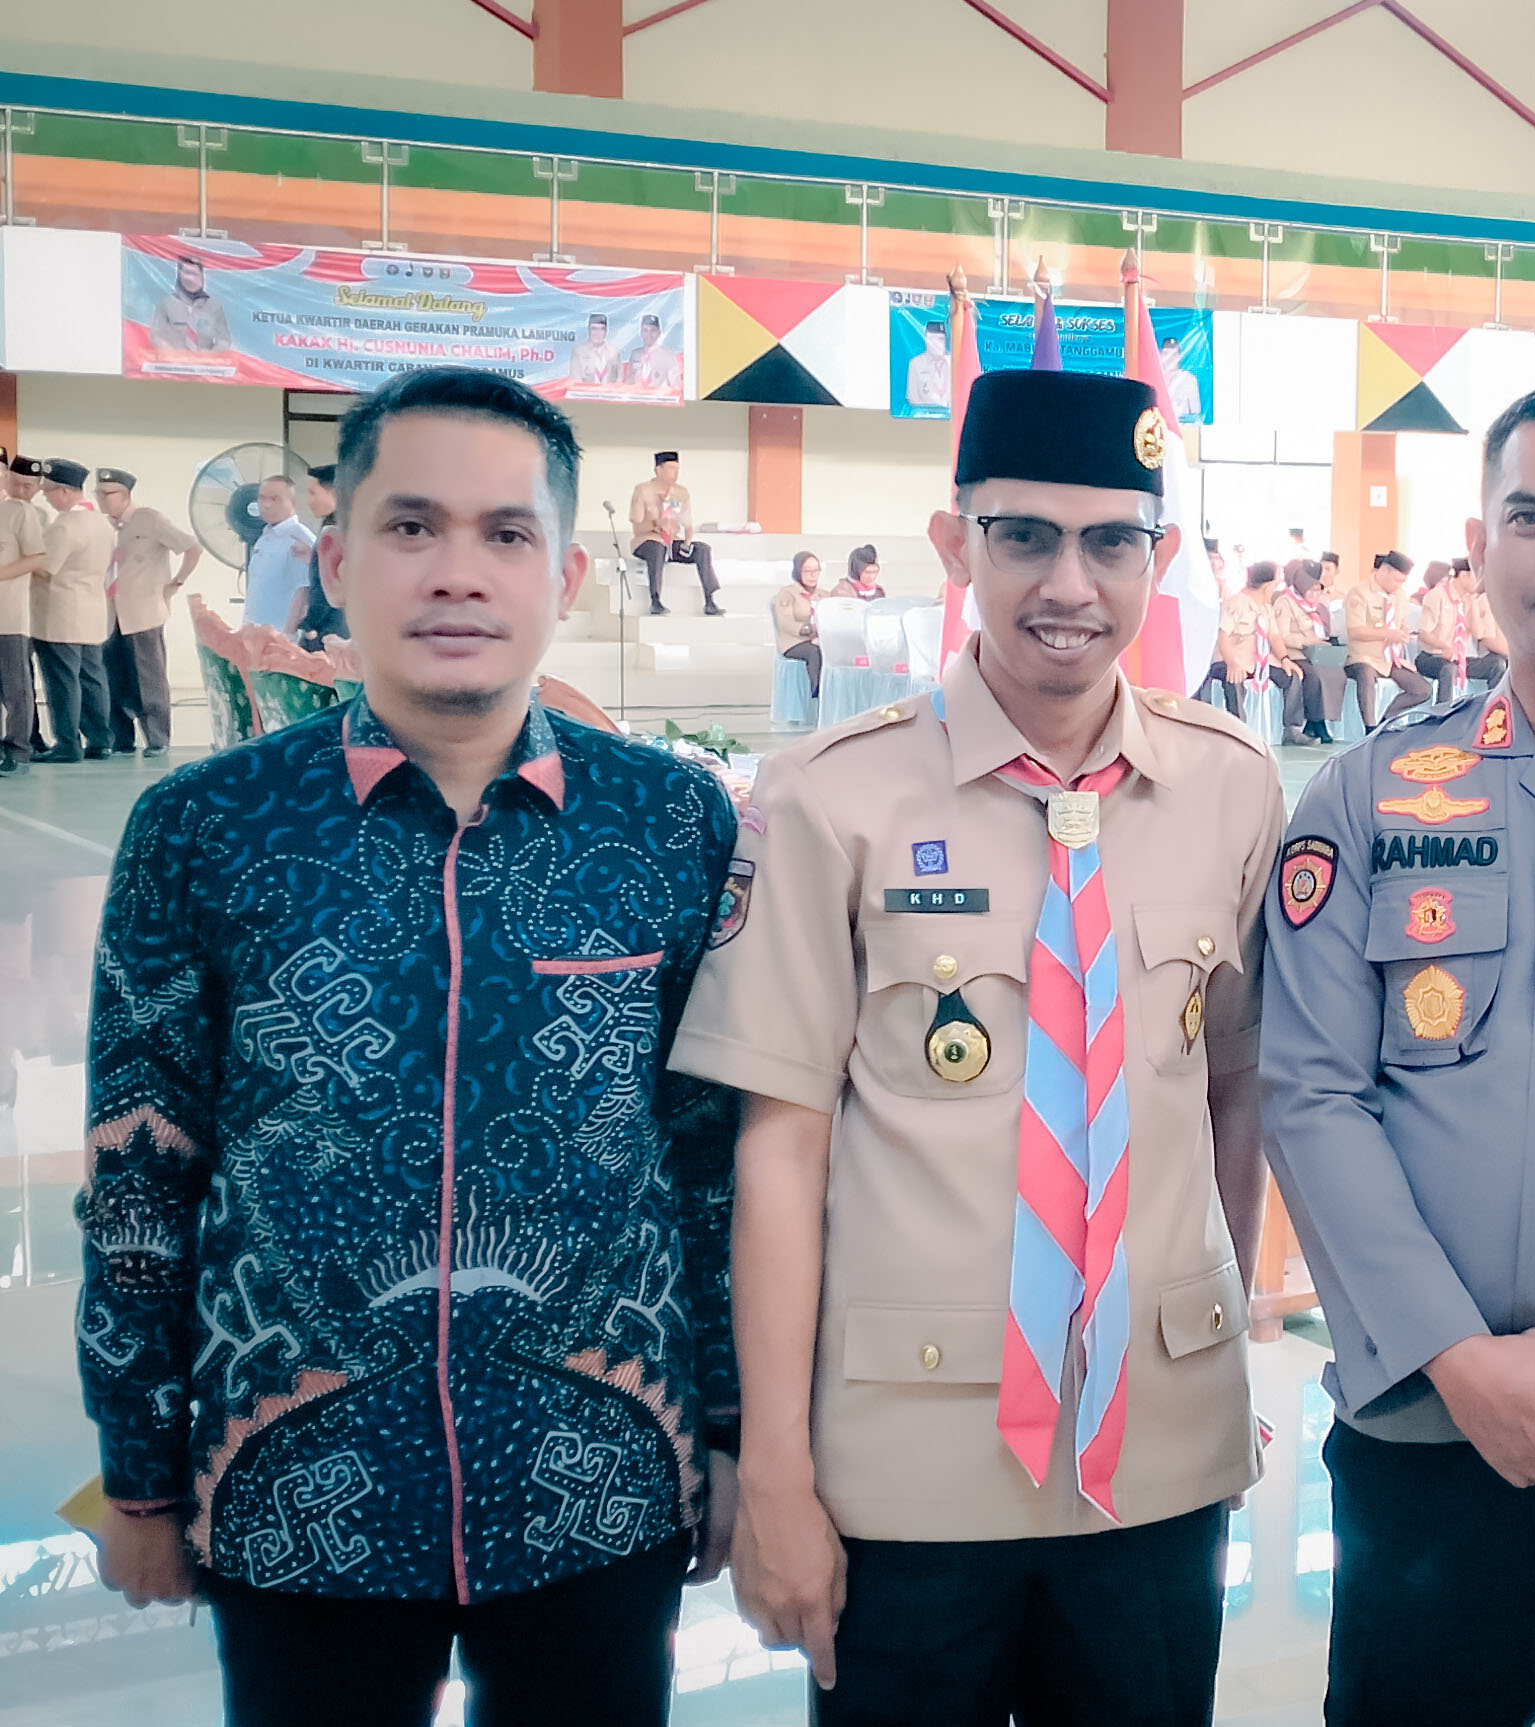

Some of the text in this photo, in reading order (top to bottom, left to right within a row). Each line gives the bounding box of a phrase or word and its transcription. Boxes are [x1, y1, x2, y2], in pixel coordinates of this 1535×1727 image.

[252, 311, 576, 342] KETUA KWARTIR DAERAH GERAKAN PRAMUKA LAMPUNG
[1066, 317, 1116, 332] SUKSES
[274, 332, 332, 349] KAKAK
[520, 347, 555, 362] Ph.D
[1061, 345, 1124, 358] TANGGAMU
[305, 357, 319, 369] DI
[322, 358, 384, 372] KWARTIR
[1371, 834, 1499, 874] RAHMAD
